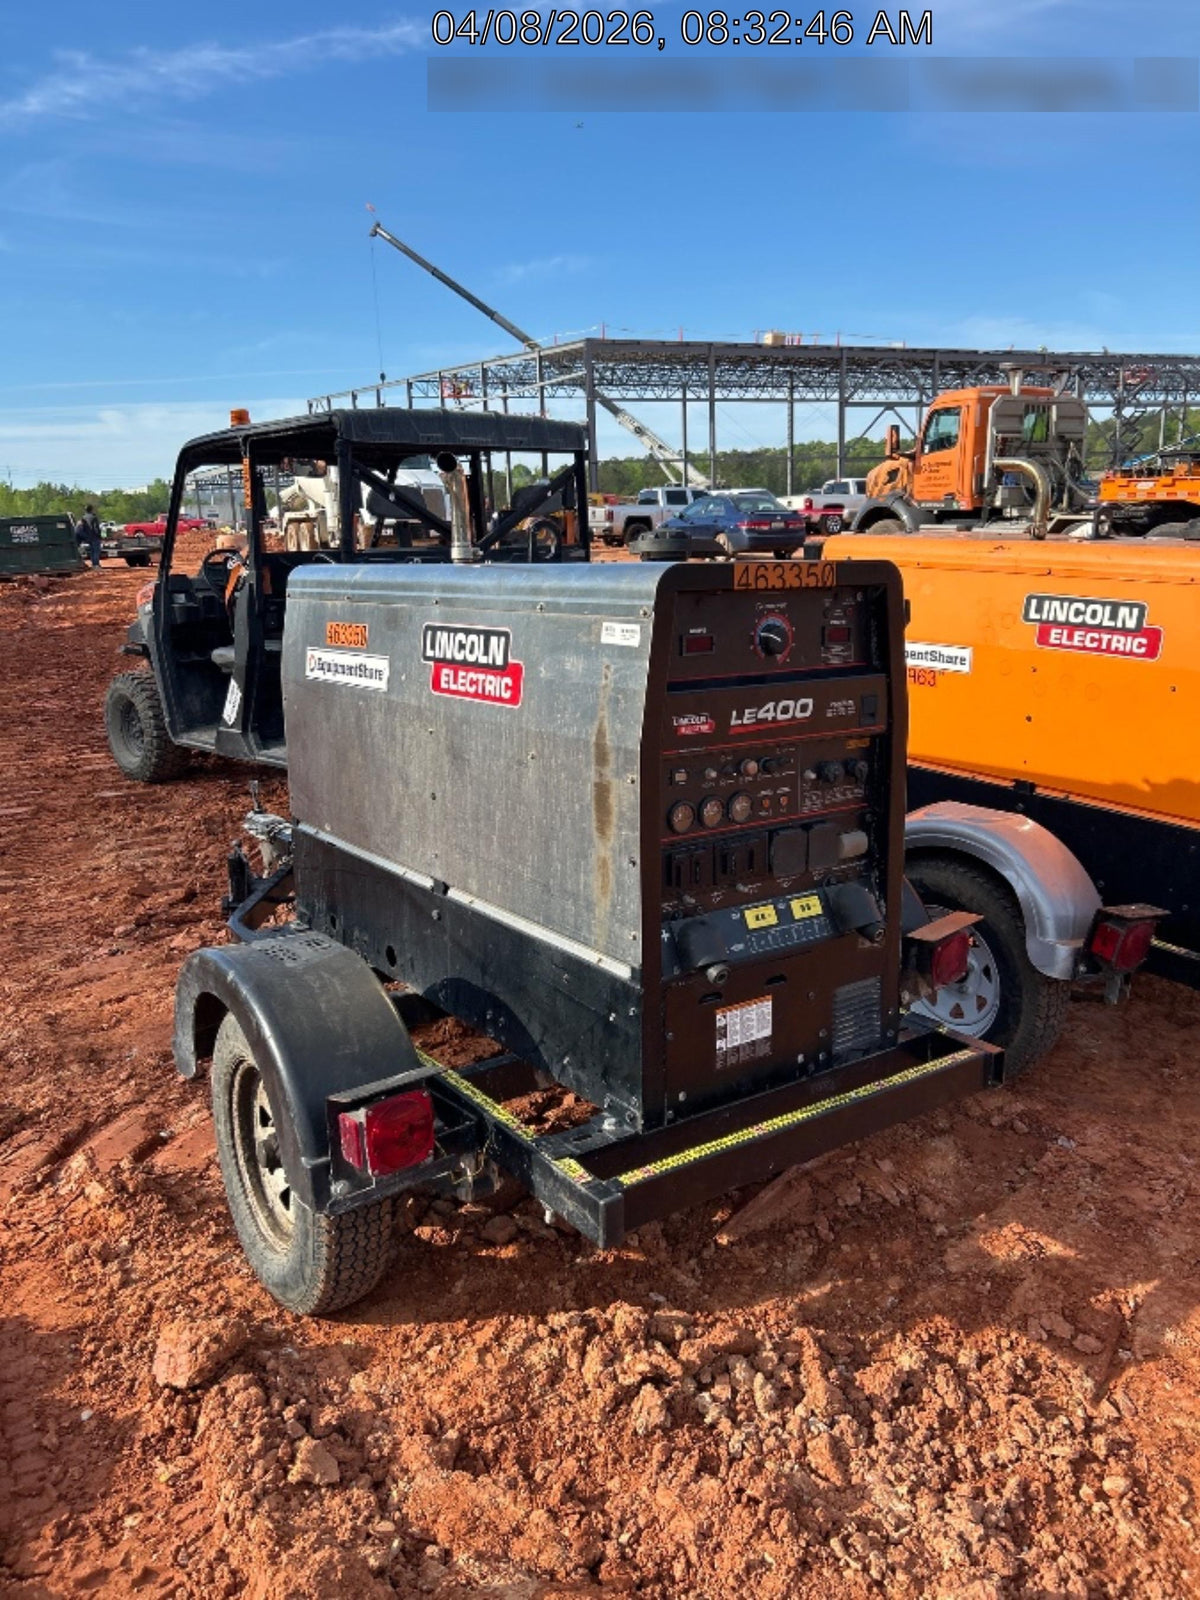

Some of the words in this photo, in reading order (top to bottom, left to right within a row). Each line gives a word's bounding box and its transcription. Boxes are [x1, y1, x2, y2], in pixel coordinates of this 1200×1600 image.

[736, 563, 835, 589] 463350
[1027, 598, 1140, 629] LINCOLN
[425, 630, 506, 666] LINCOLN
[1049, 628, 1148, 654] ELECTRIC
[440, 668, 513, 699] ELECTRIC
[730, 697, 814, 726] LE400
